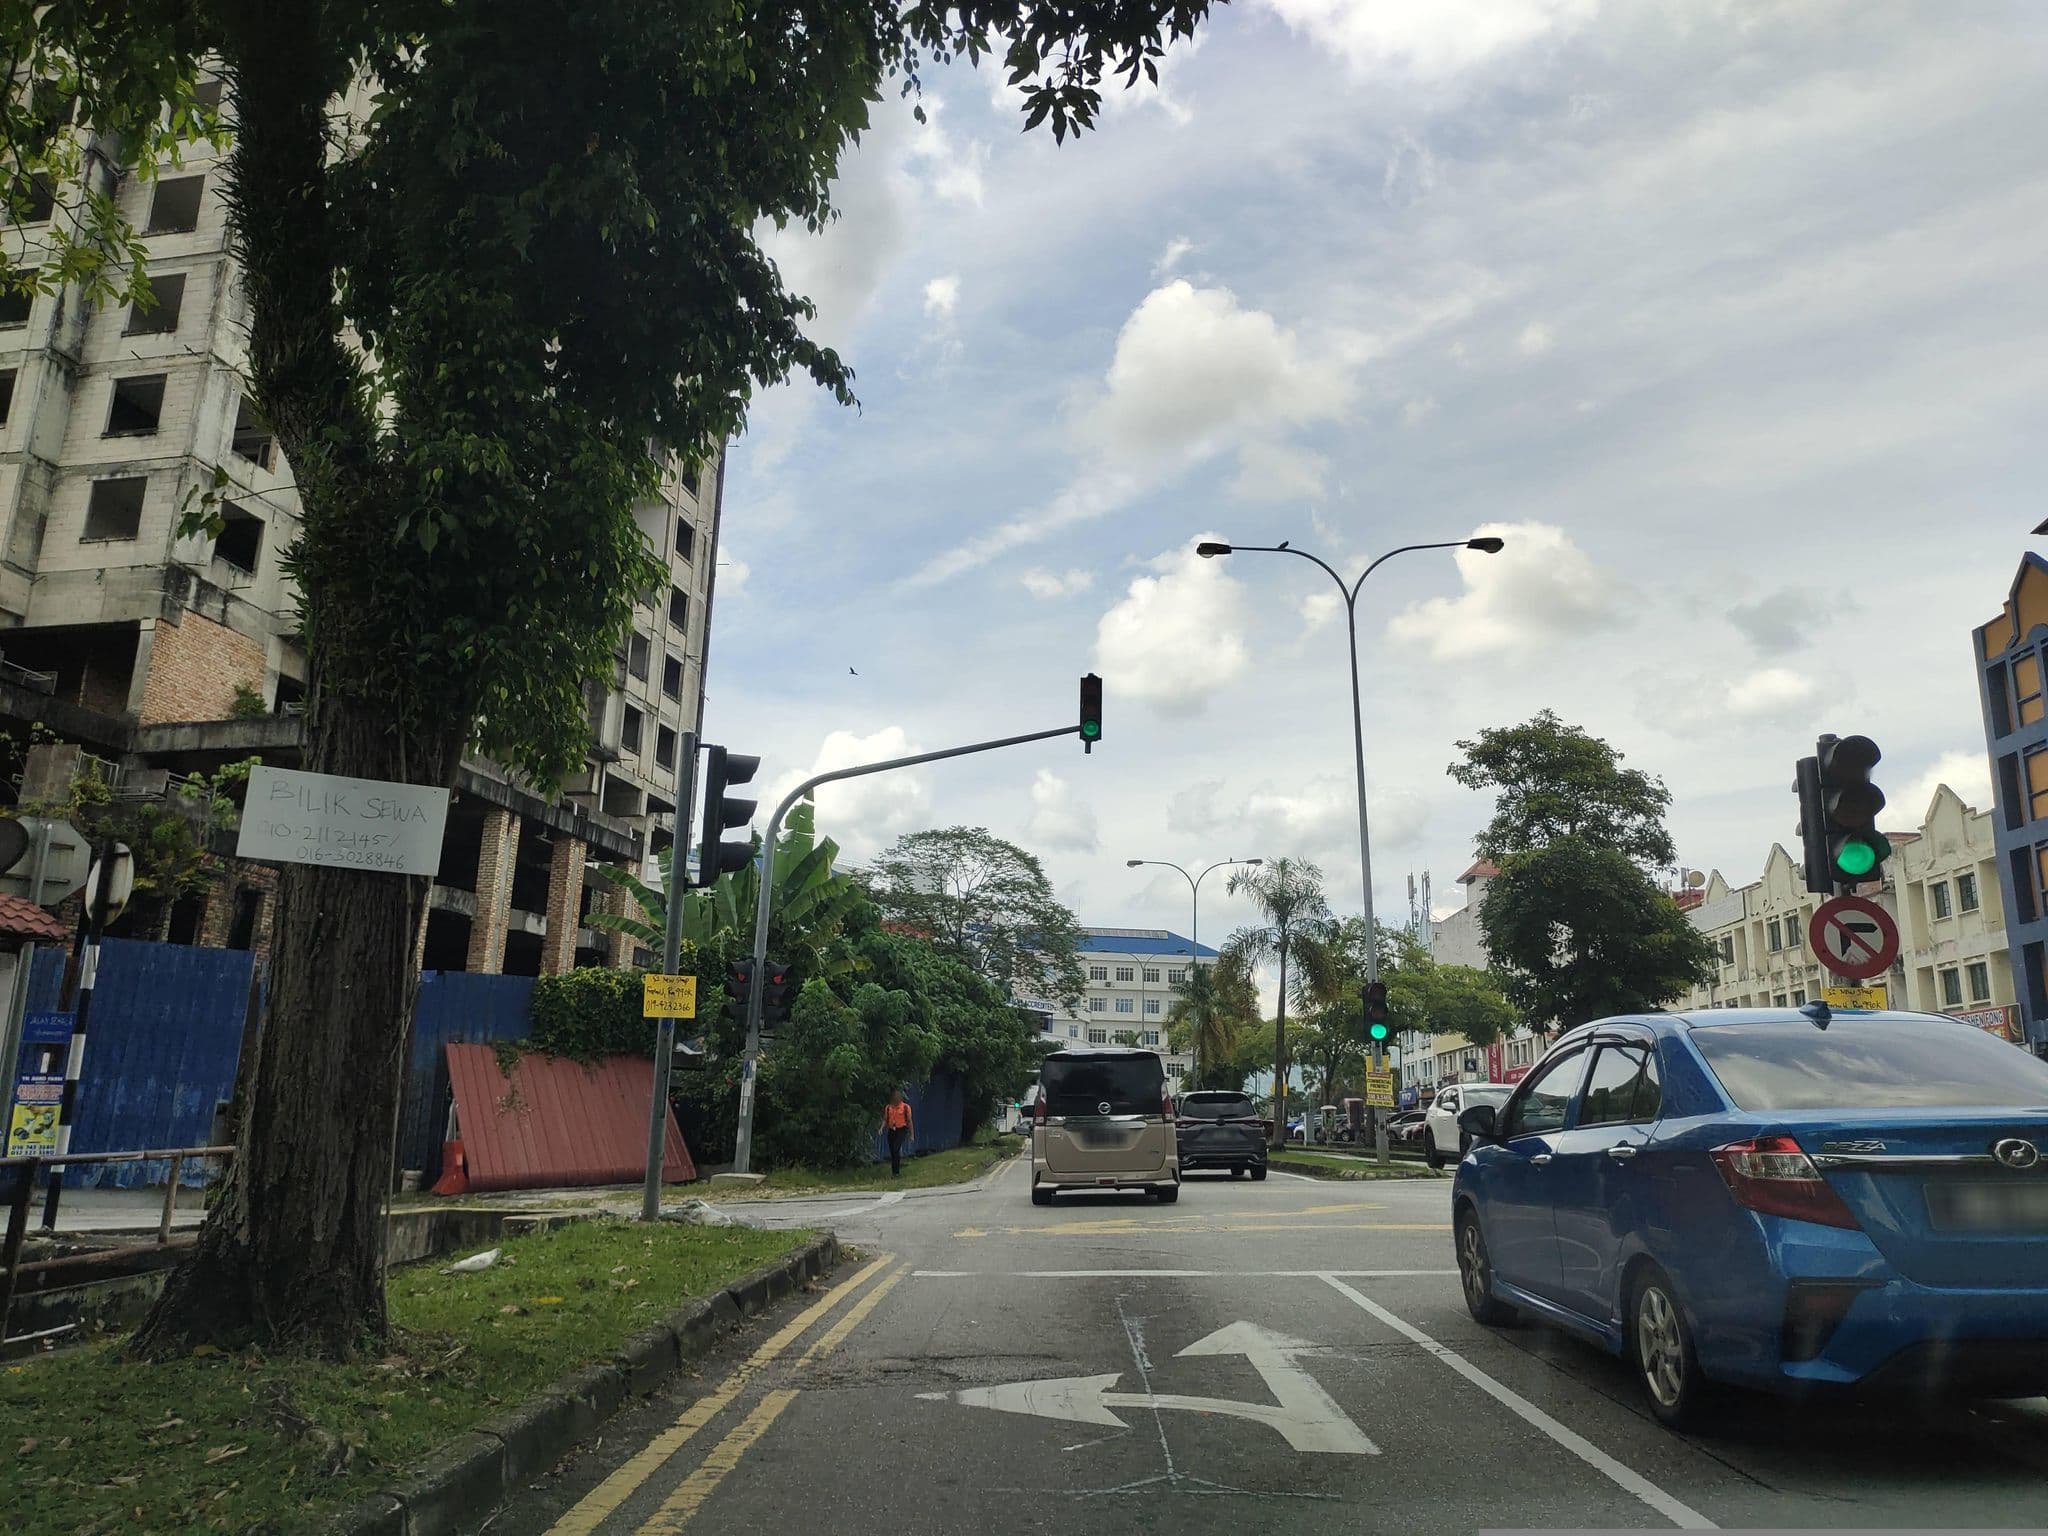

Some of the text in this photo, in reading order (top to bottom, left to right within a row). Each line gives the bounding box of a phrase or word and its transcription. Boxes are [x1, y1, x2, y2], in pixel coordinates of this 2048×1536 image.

[269, 779, 428, 823] BILIK SEWA
[1984, 1009, 2004, 1026] FONG
